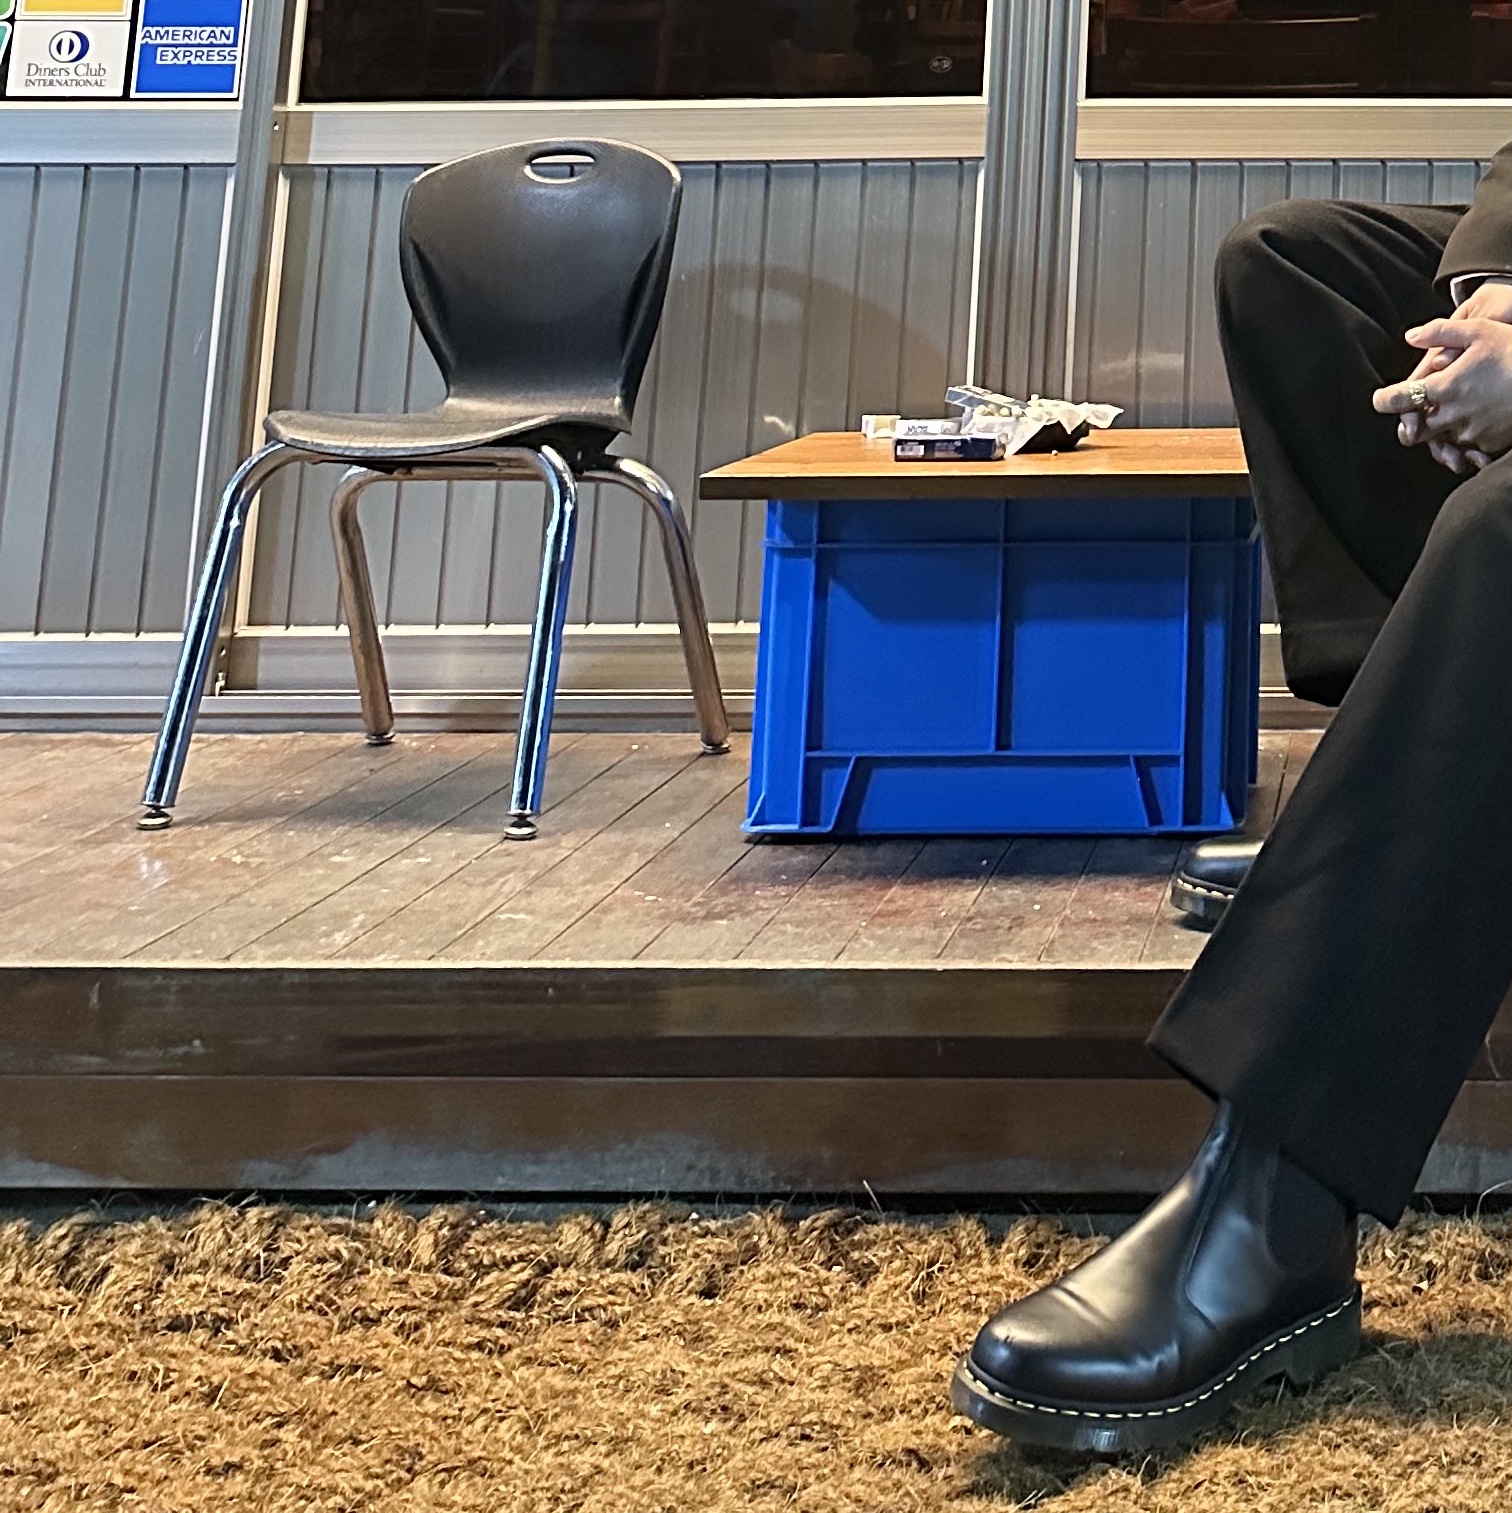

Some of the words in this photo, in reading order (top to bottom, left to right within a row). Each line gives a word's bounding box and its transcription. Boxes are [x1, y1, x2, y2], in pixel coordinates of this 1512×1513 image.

[141, 29, 232, 43] AMERICAN
[159, 49, 238, 62] EXPRESS
[26, 63, 70, 77] Diners
[73, 62, 107, 77] Club
[25, 78, 107, 88] INTERNATIONAL
